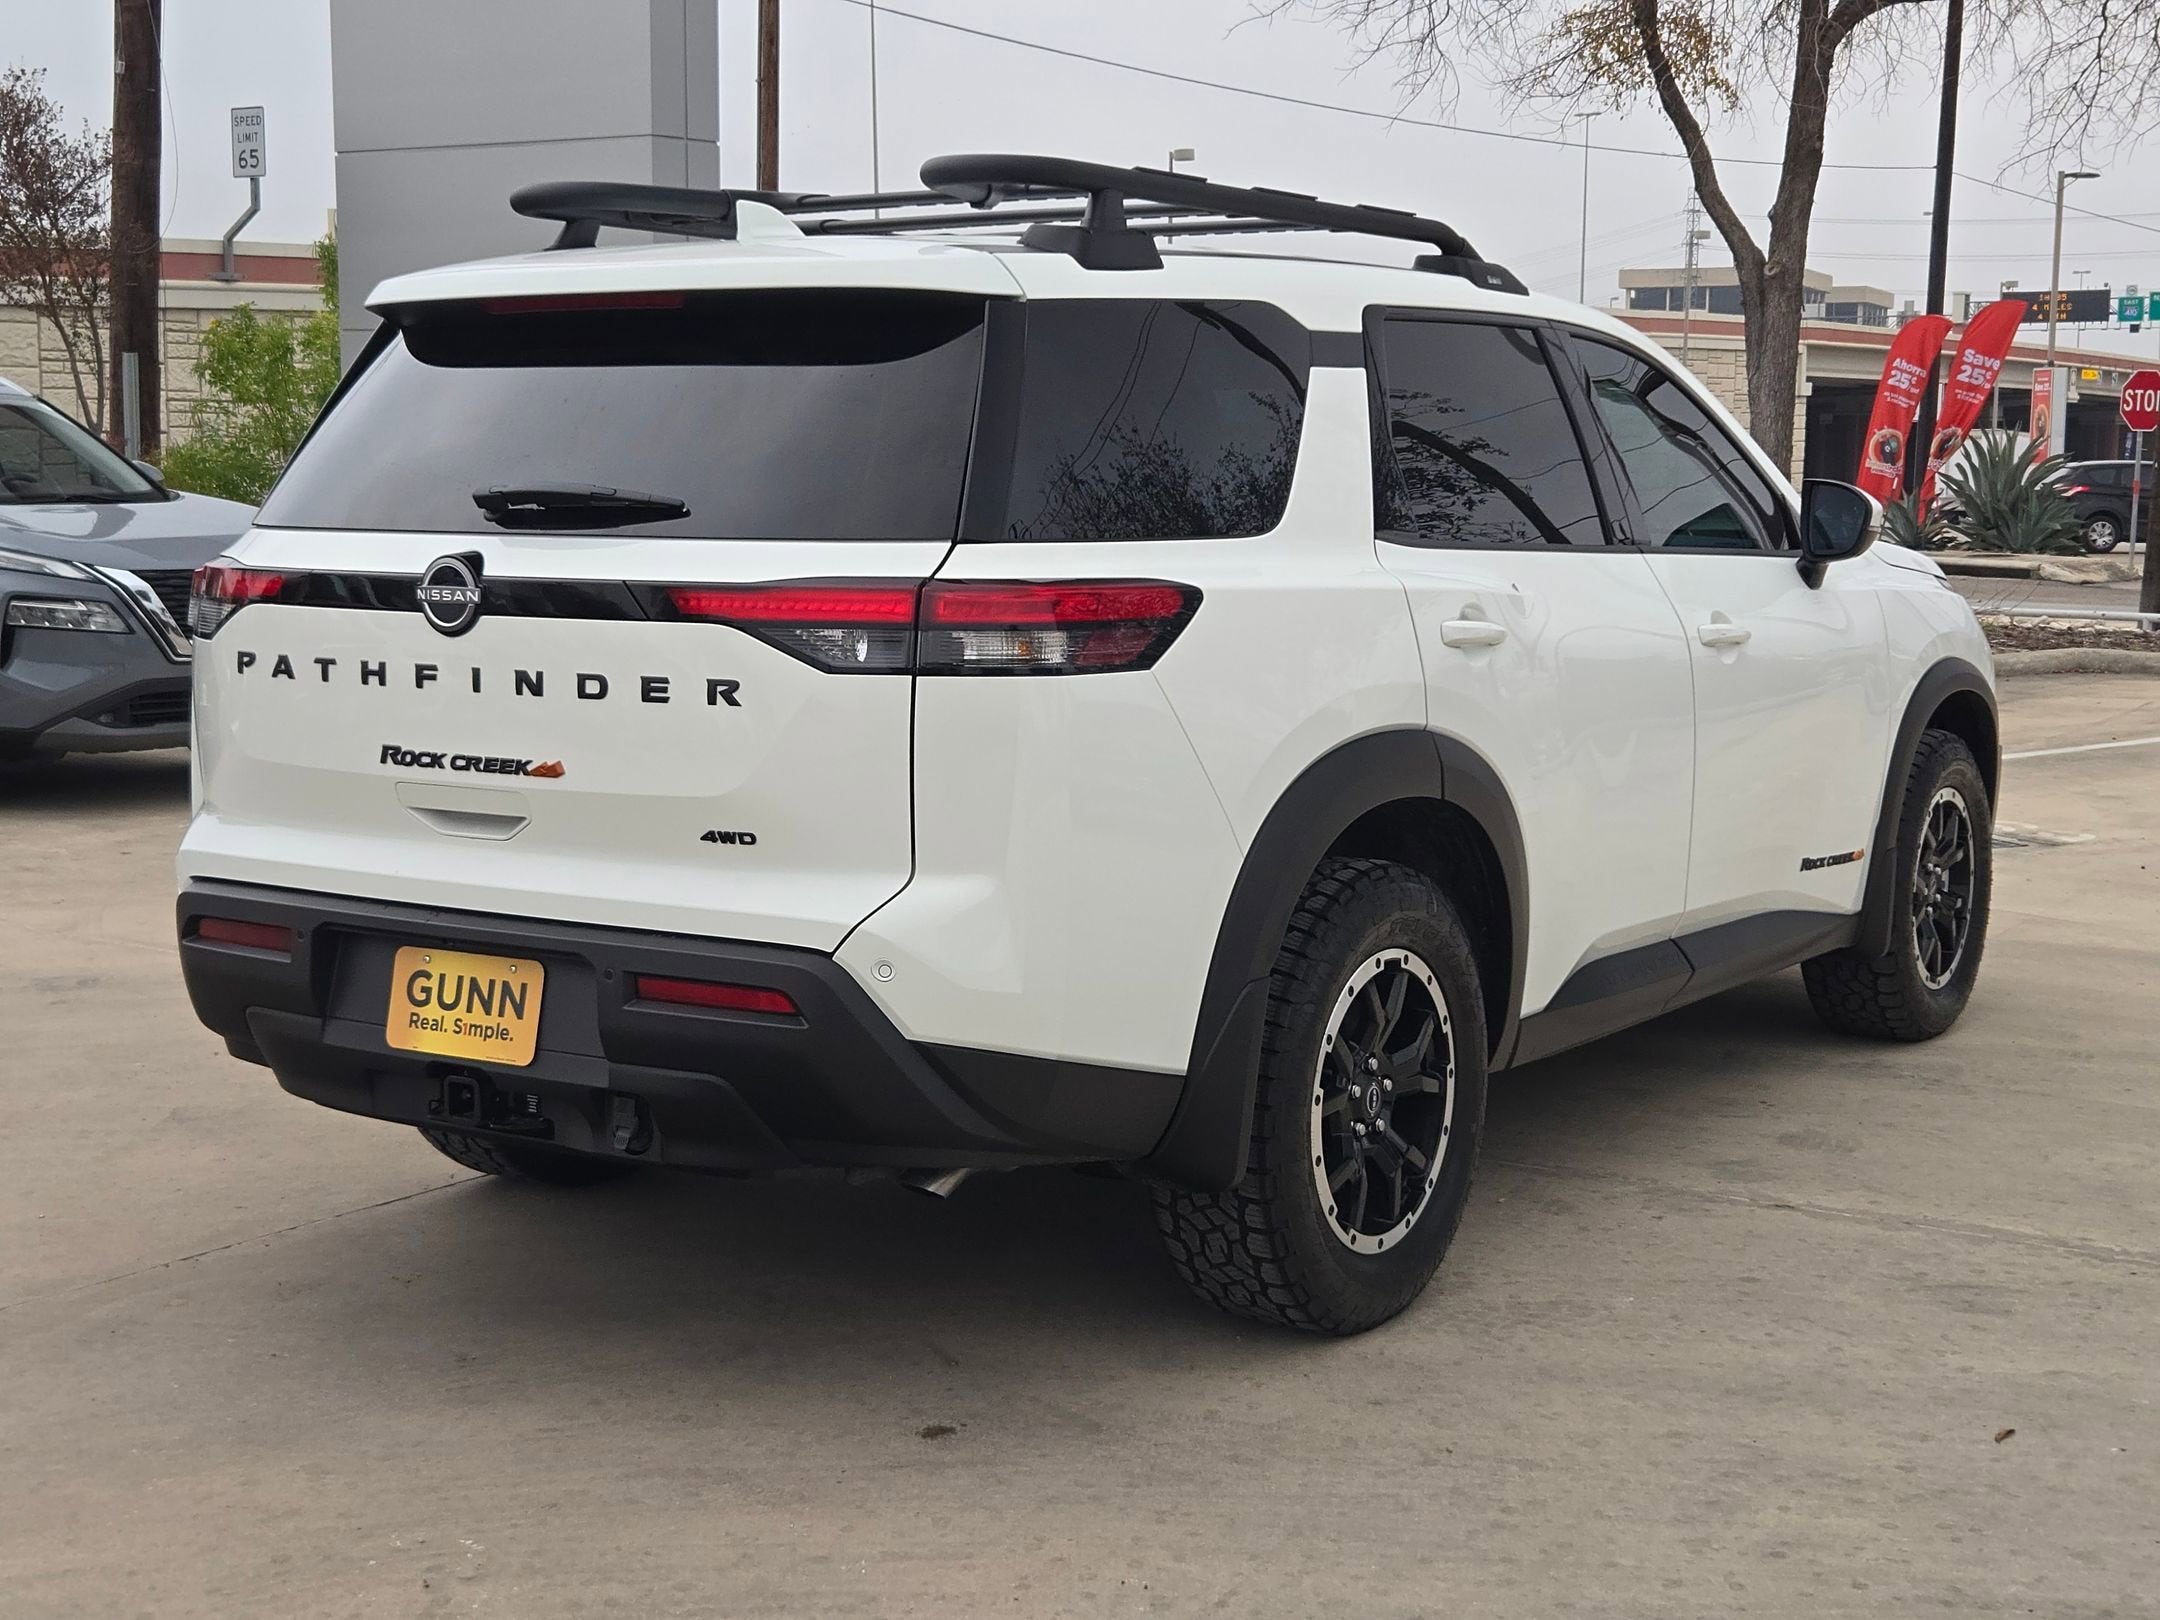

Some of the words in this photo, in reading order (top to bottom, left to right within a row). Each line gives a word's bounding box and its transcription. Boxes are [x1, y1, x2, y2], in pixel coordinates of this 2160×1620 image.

[234, 115, 262, 127] SPEED
[237, 131, 258, 143] LIMIT
[239, 149, 259, 169] 65
[1892, 358, 1927, 378] Ahorra
[1962, 348, 2001, 371] Save
[417, 587, 479, 603] NISSAN
[236, 650, 743, 708] PATHFINDER
[450, 754, 533, 776] CREEK
[700, 830, 758, 846] 4WD
[406, 969, 529, 1021] GUNN
[408, 1012, 449, 1034] Real.
